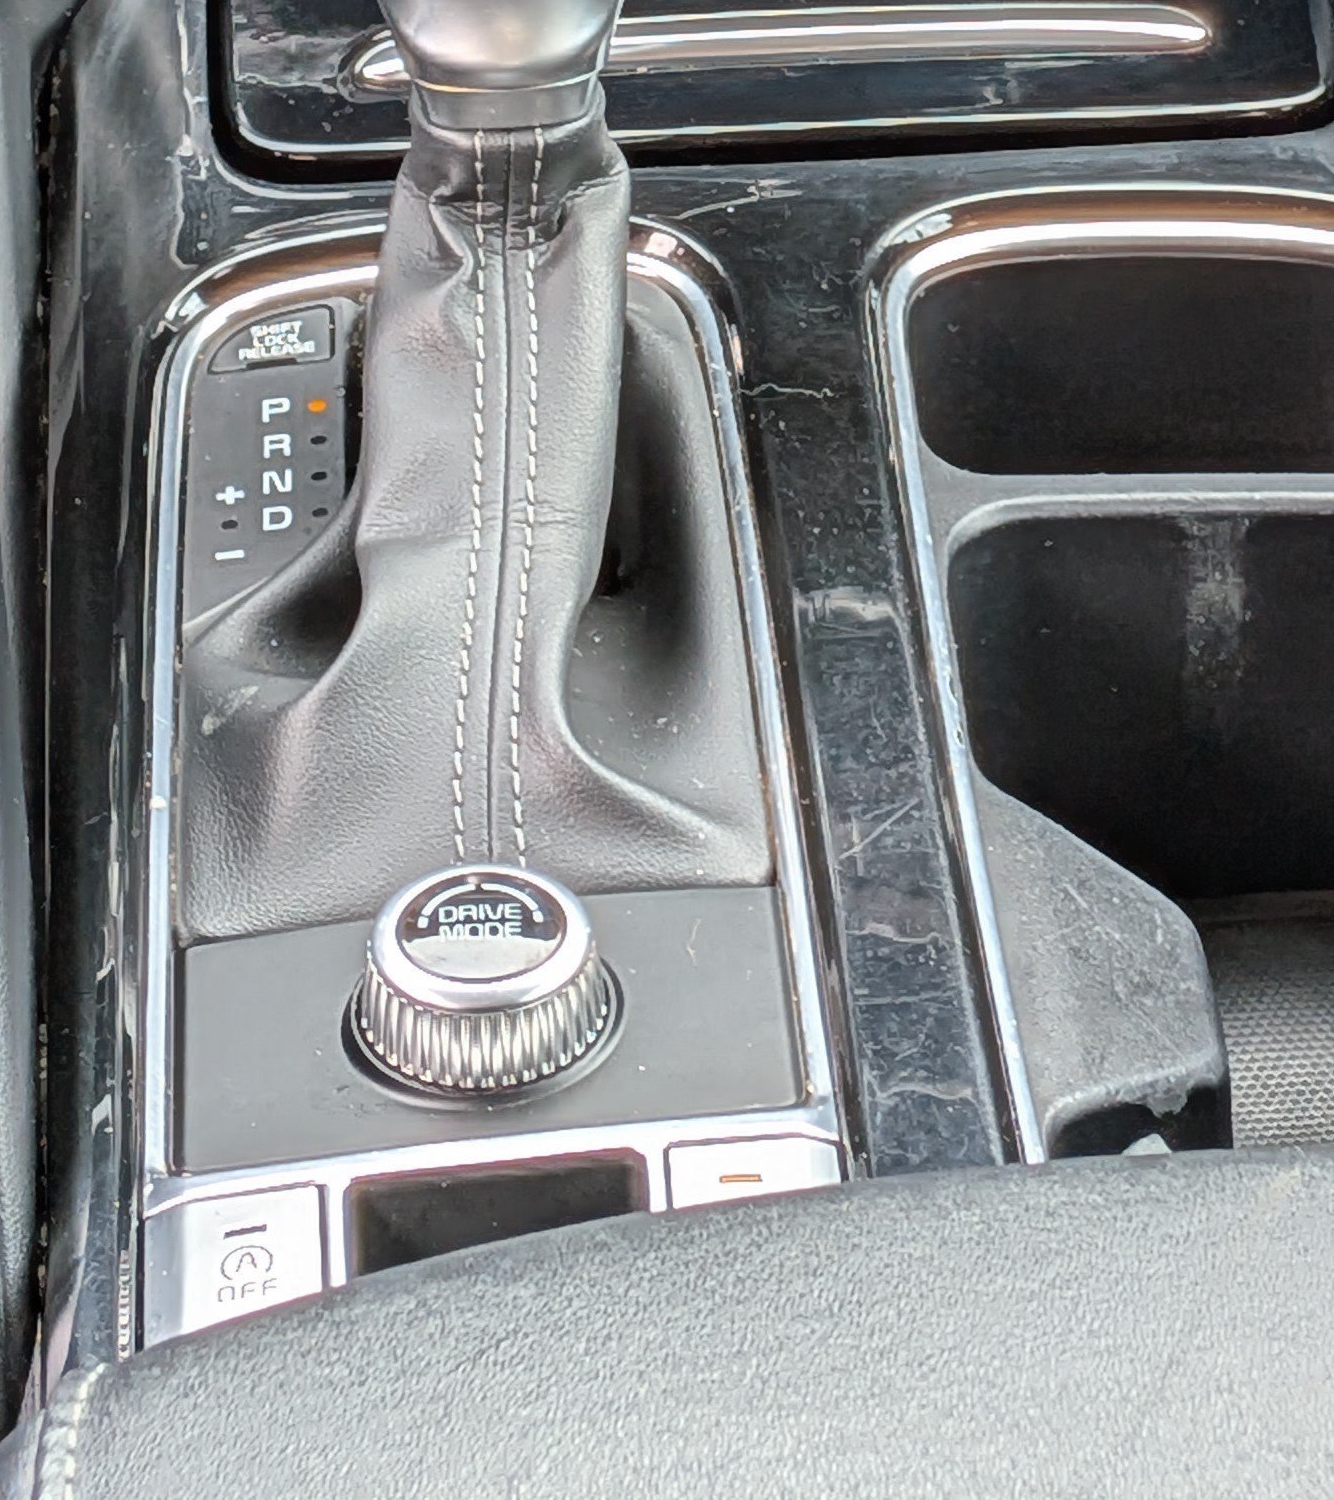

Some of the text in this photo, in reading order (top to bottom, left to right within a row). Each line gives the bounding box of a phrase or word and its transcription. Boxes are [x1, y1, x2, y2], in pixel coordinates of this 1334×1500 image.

[261, 397, 291, 423] P
[263, 433, 292, 459] R
[262, 468, 293, 495] N
[262, 505, 293, 531] D
[438, 902, 523, 924] DRIVE
[438, 921, 523, 942] MODE
